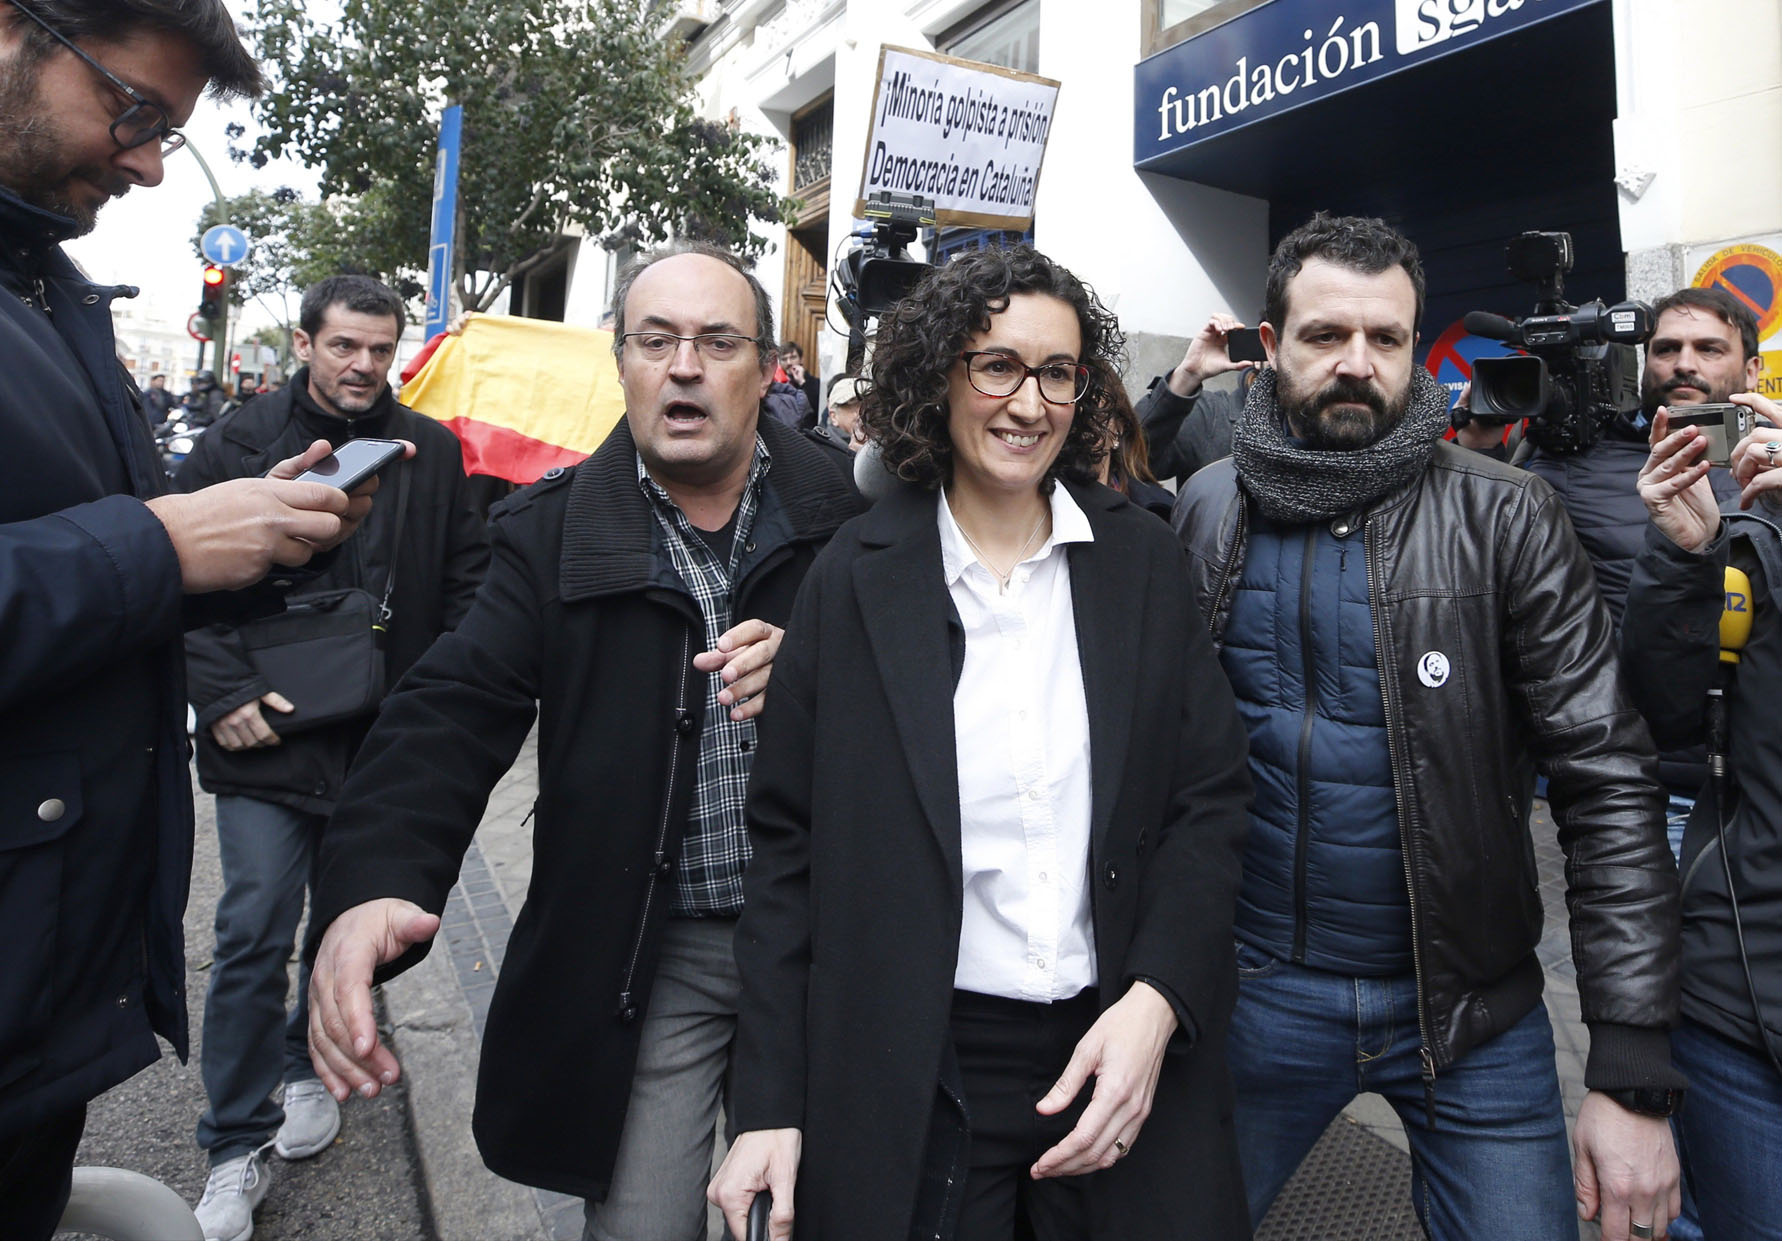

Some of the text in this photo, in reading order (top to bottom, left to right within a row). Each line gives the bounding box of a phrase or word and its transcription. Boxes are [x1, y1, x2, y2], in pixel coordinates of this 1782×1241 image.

[1157, 0, 1546, 142] fundación sg
[881, 71, 943, 127] ¡Minoría
[943, 87, 999, 142] golpista
[997, 104, 1009, 137] a
[958, 167, 980, 199] en
[1694, 246, 1782, 282] SALIDA DE VEHICULO
